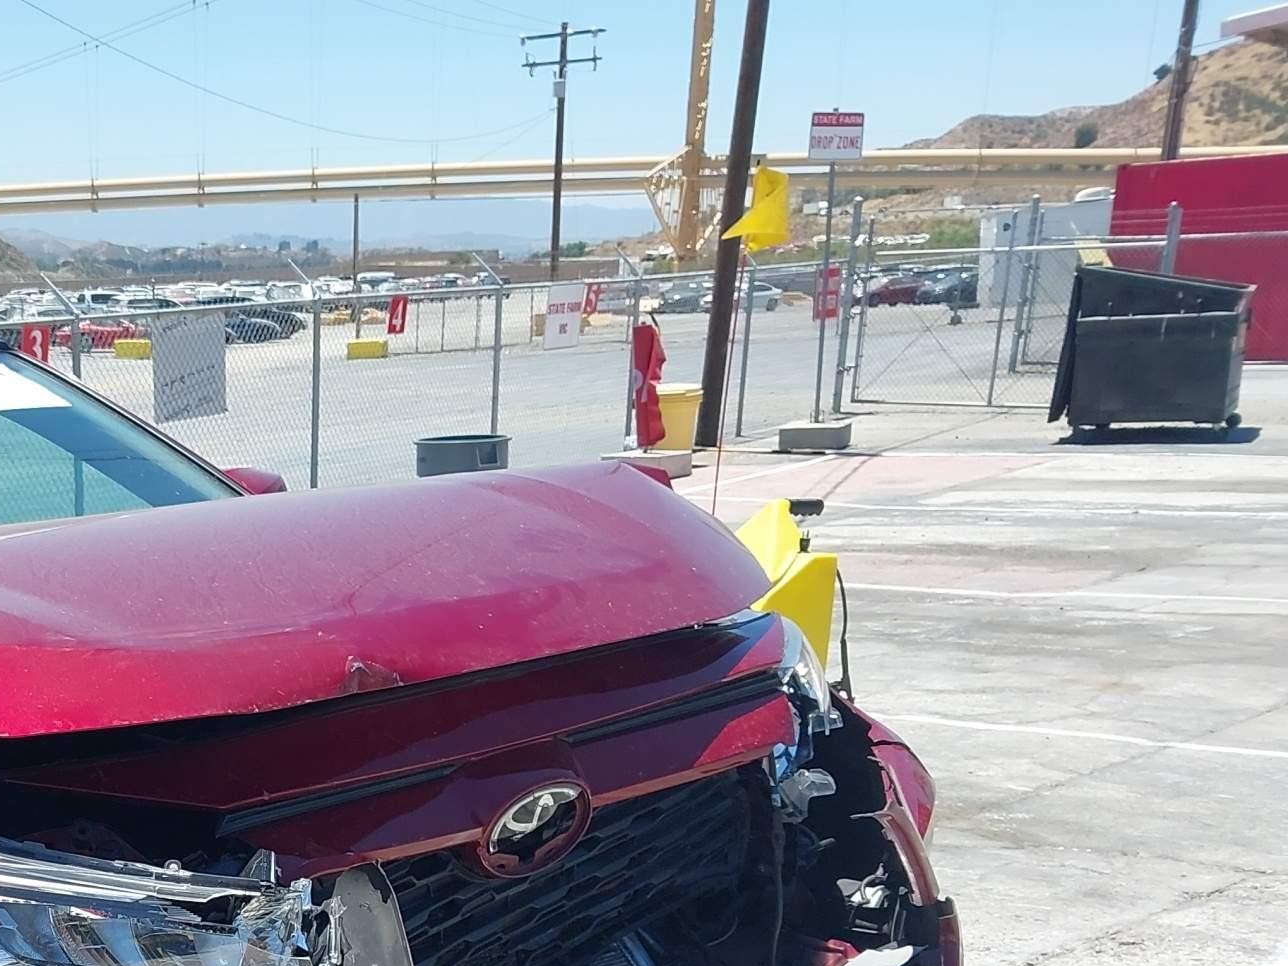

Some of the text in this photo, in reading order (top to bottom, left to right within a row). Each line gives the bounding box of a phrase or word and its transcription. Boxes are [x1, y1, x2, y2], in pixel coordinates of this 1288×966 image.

[813, 115, 863, 124] STATE FARM
[811, 136, 861, 149] DROP ZONE
[392, 300, 404, 331] 4
[28, 329, 43, 361] 3
